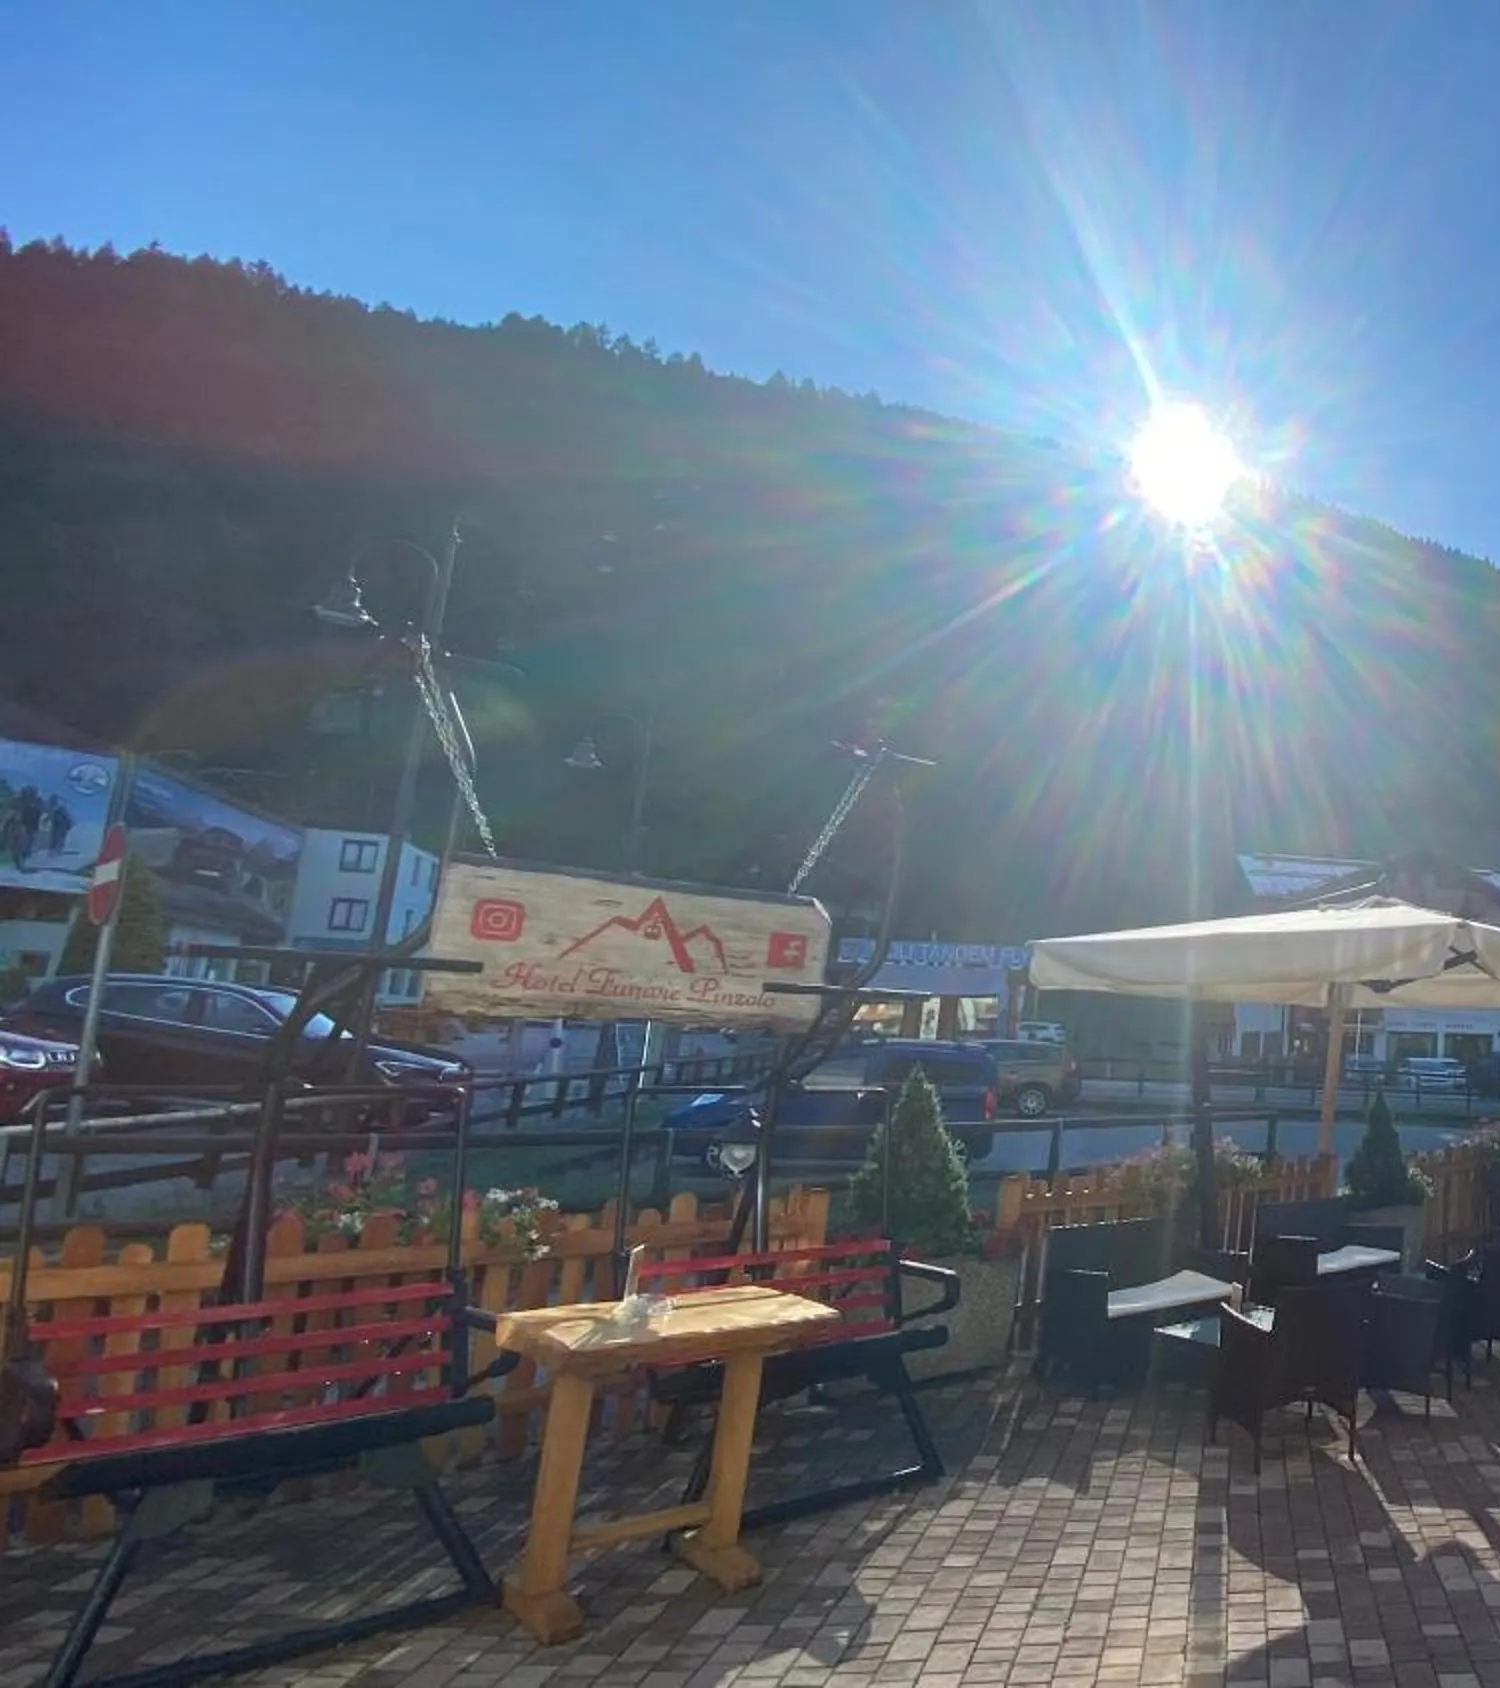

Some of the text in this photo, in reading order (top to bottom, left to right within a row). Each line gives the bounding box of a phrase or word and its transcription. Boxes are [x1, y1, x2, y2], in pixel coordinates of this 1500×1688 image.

[491, 960, 776, 1009] Hotel Funivie Pinzolo
